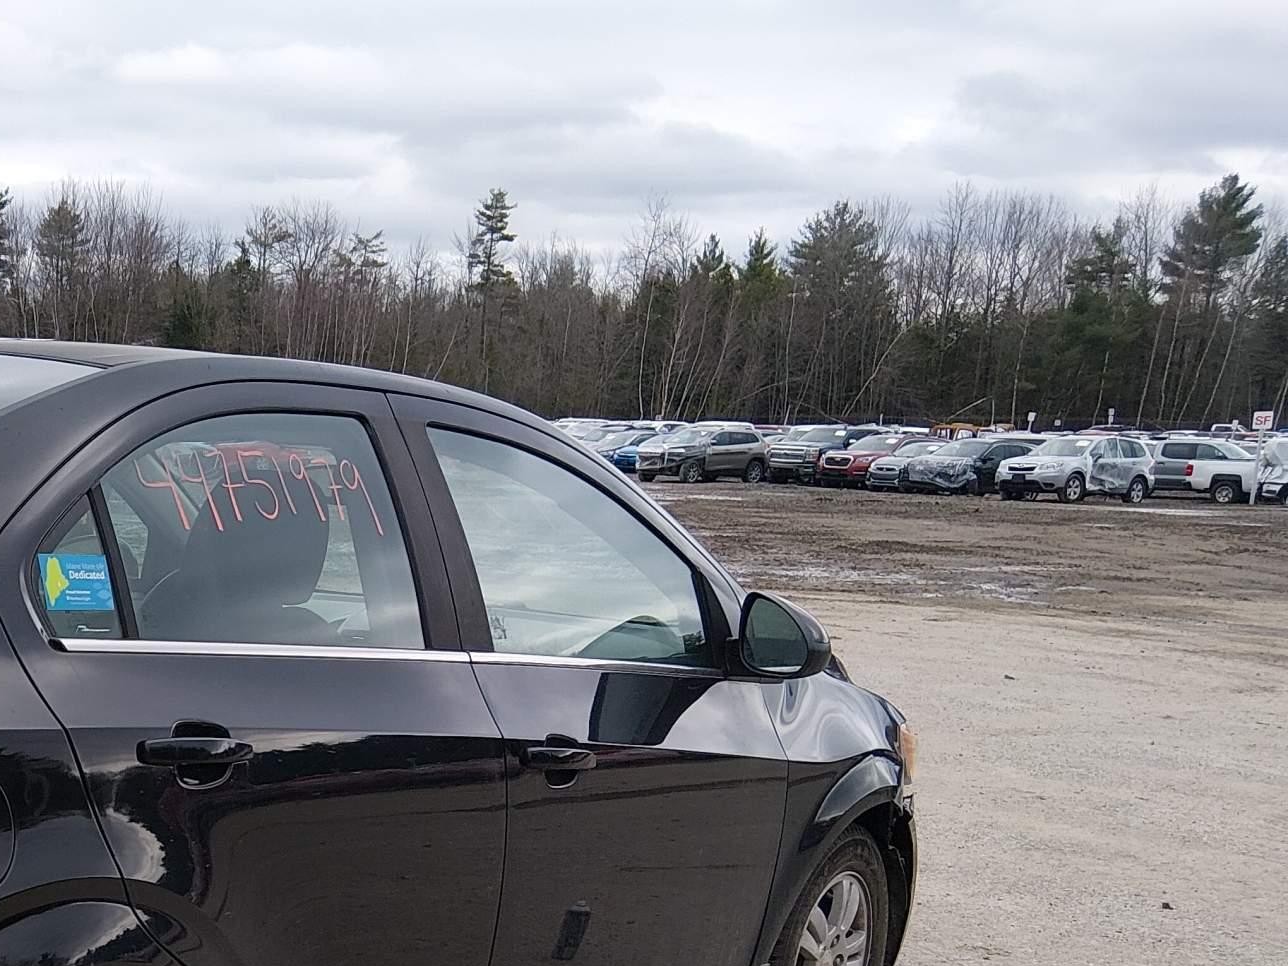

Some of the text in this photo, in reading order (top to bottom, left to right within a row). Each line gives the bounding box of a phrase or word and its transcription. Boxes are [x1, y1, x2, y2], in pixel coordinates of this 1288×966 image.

[1255, 415, 1271, 425] SF
[133, 448, 385, 537] 44751979
[68, 570, 105, 580] Dedicated
